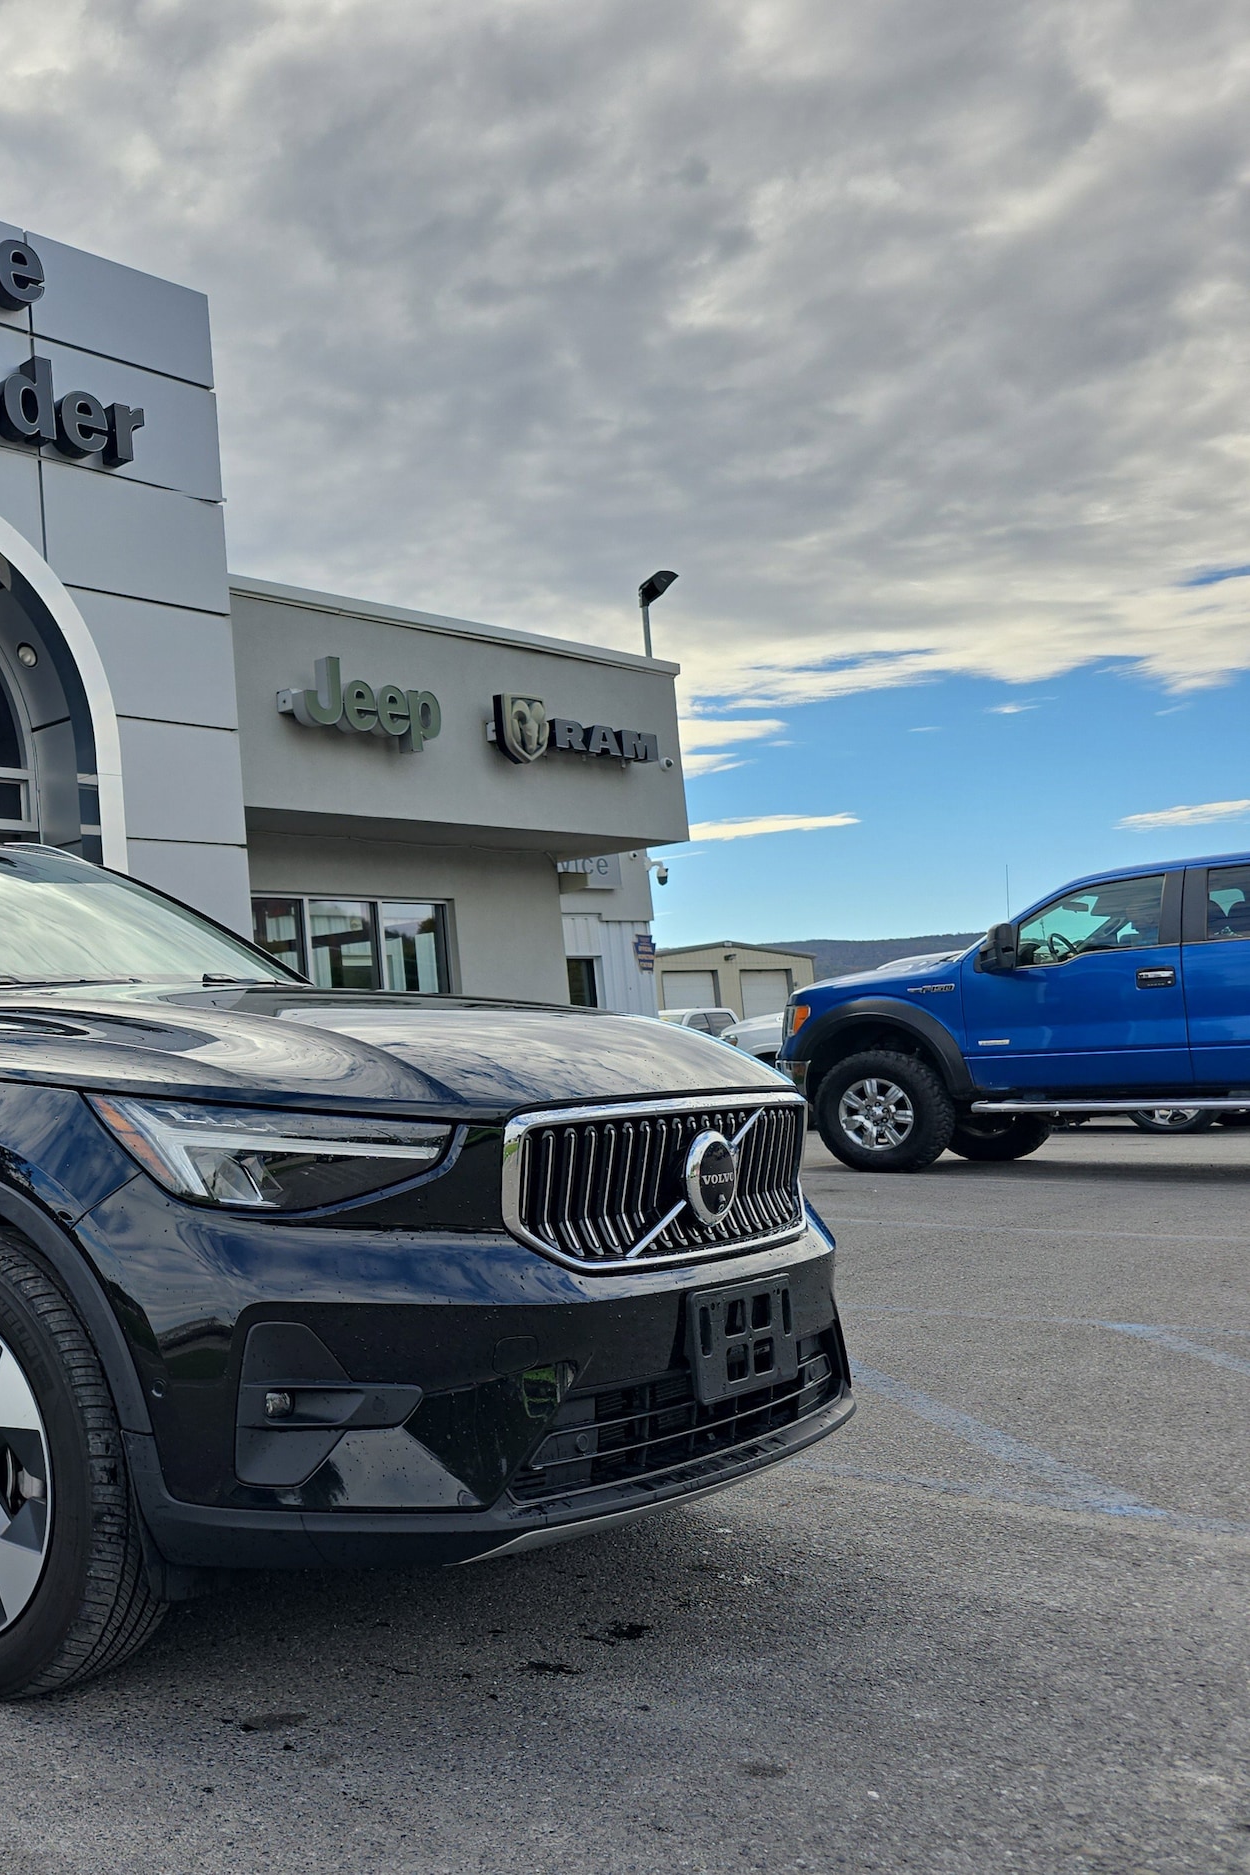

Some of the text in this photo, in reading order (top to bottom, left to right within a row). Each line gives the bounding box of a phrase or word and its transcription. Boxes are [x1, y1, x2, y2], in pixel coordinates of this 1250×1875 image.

[292, 656, 442, 753] Jeep
[548, 718, 659, 763] RAM
[701, 1172, 734, 1185] VOLVO
